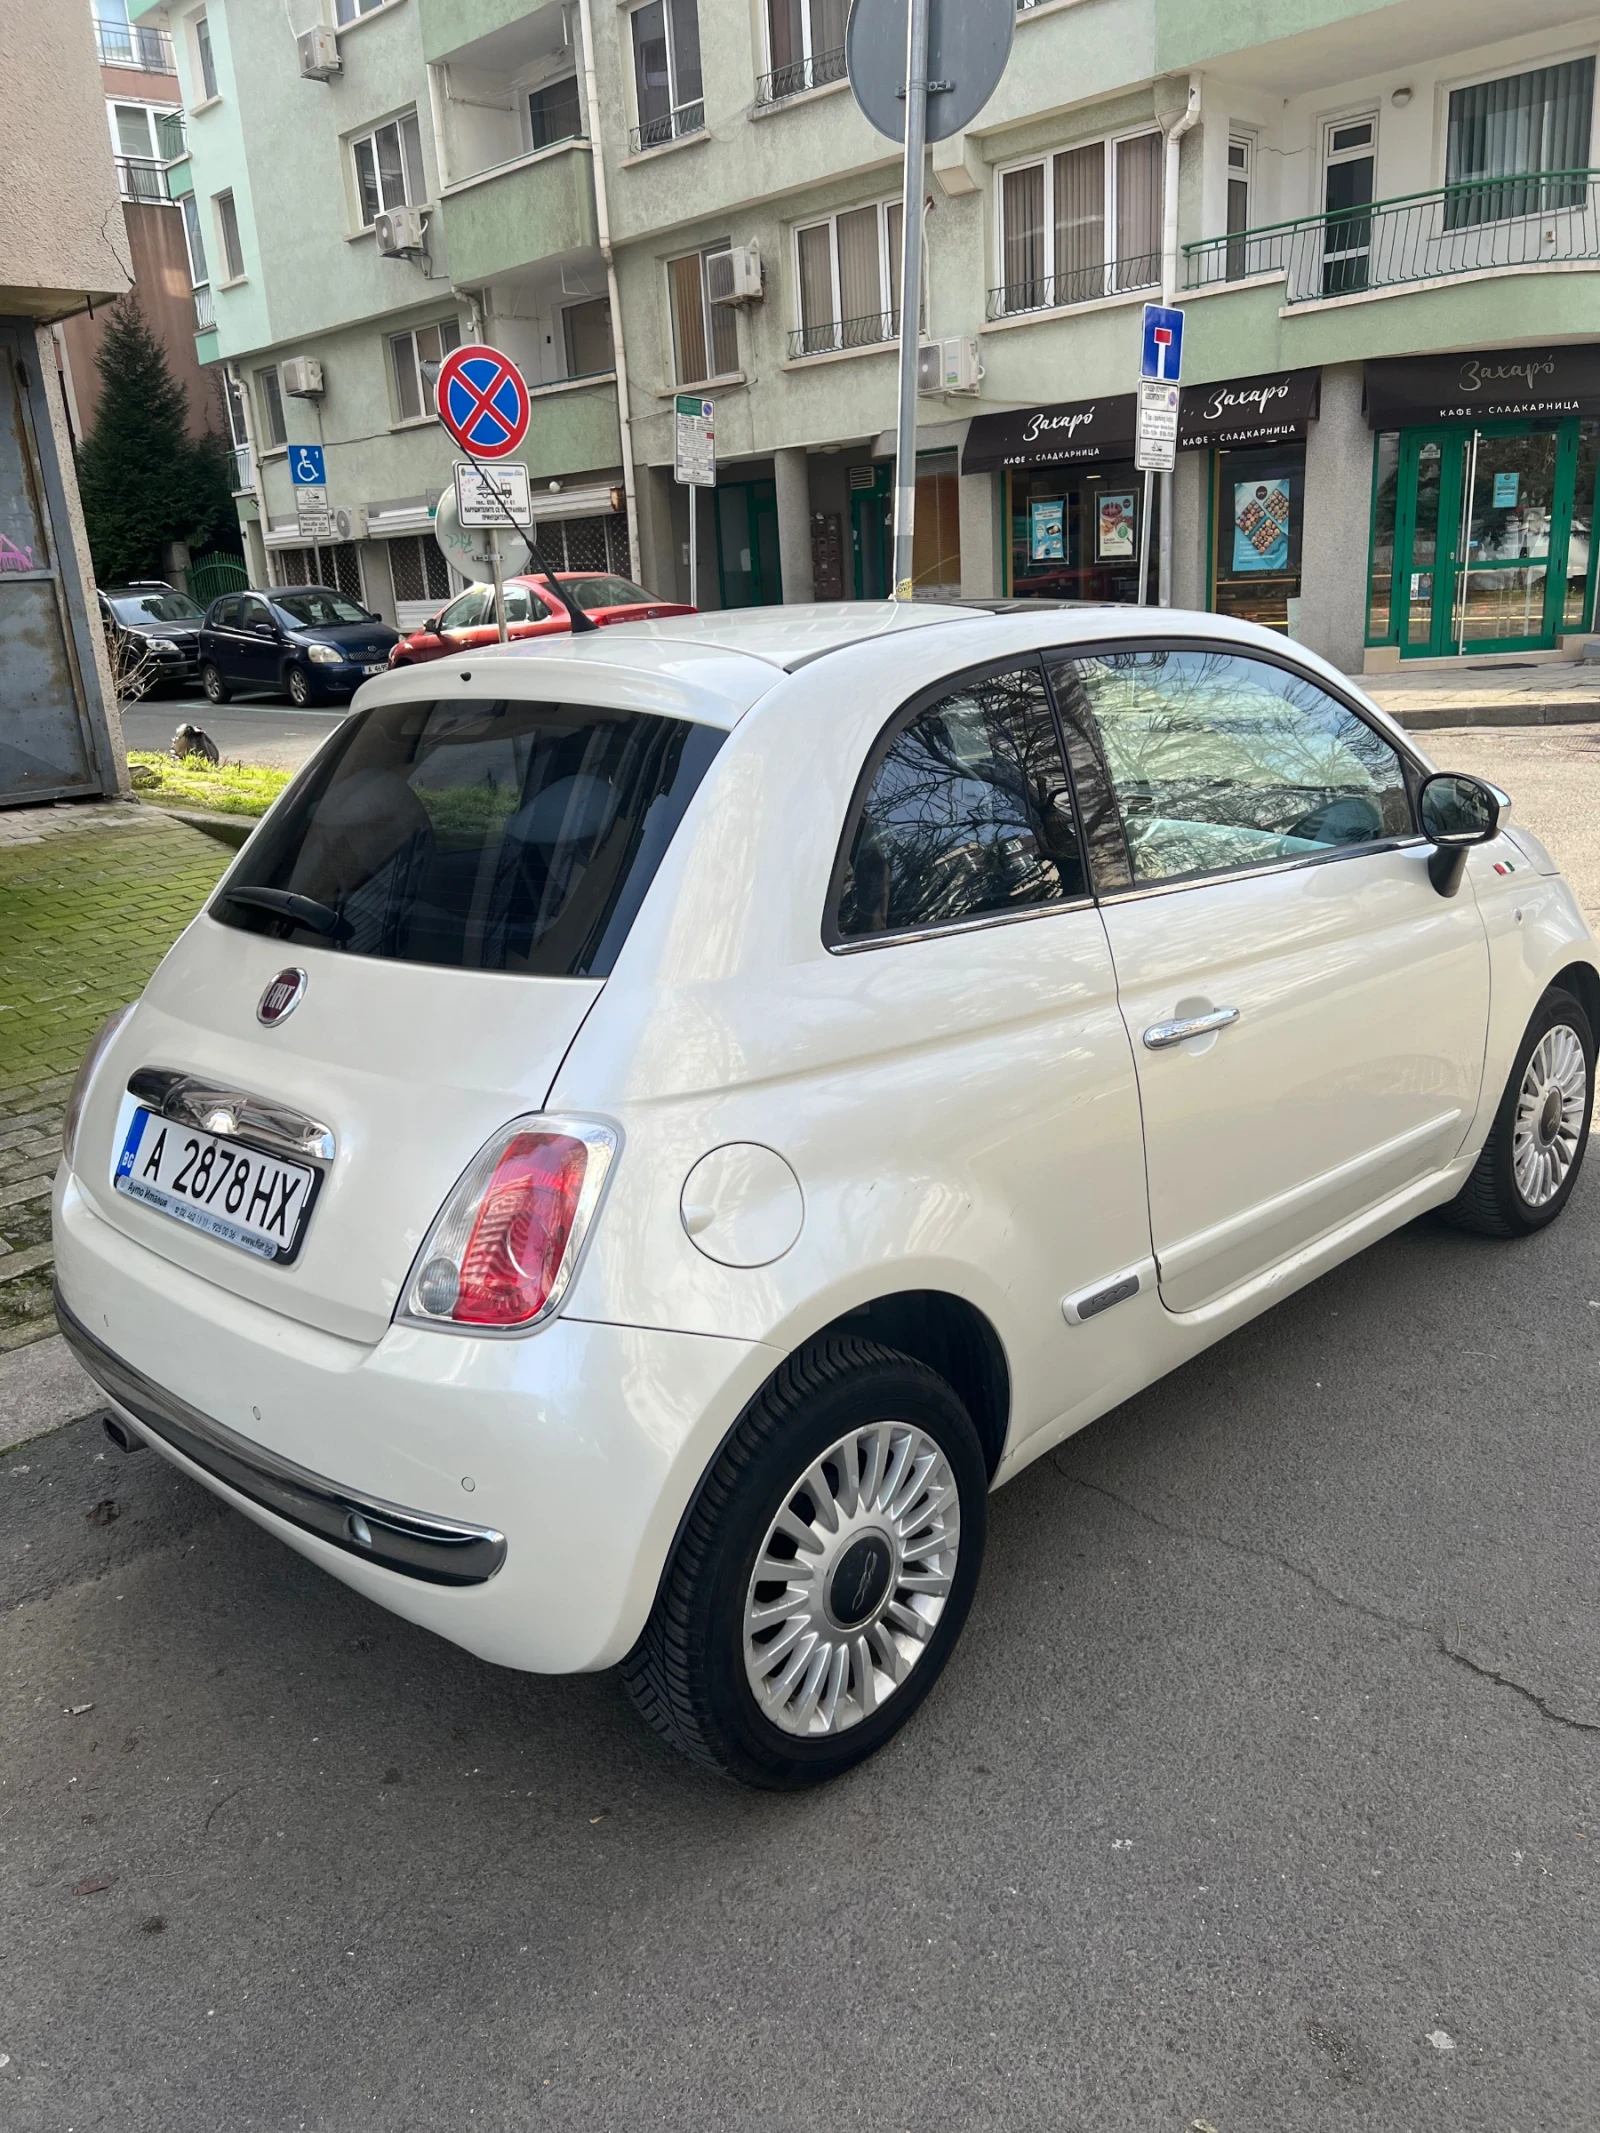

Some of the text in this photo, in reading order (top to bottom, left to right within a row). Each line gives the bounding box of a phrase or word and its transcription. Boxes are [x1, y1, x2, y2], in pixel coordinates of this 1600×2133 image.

[1440, 408, 1472, 417] КАФЕ
[1488, 401, 1580, 413] СЛАДКАРНИЦА
[1182, 436, 1209, 446] КАФЕ
[1219, 424, 1296, 441] СЛАДКАРНИЦА
[314, 450, 319, 459] 1
[1003, 456, 1026, 464] КАФЕ
[1035, 447, 1100, 462] СЛАДКАРНИЦА
[264, 982, 296, 1010] FIAT
[122, 1151, 135, 1168] BG
[142, 1127, 168, 1182] A
[127, 1181, 168, 1208] Ауто Италия
[240, 1234, 273, 1257] www.fiat.bg
